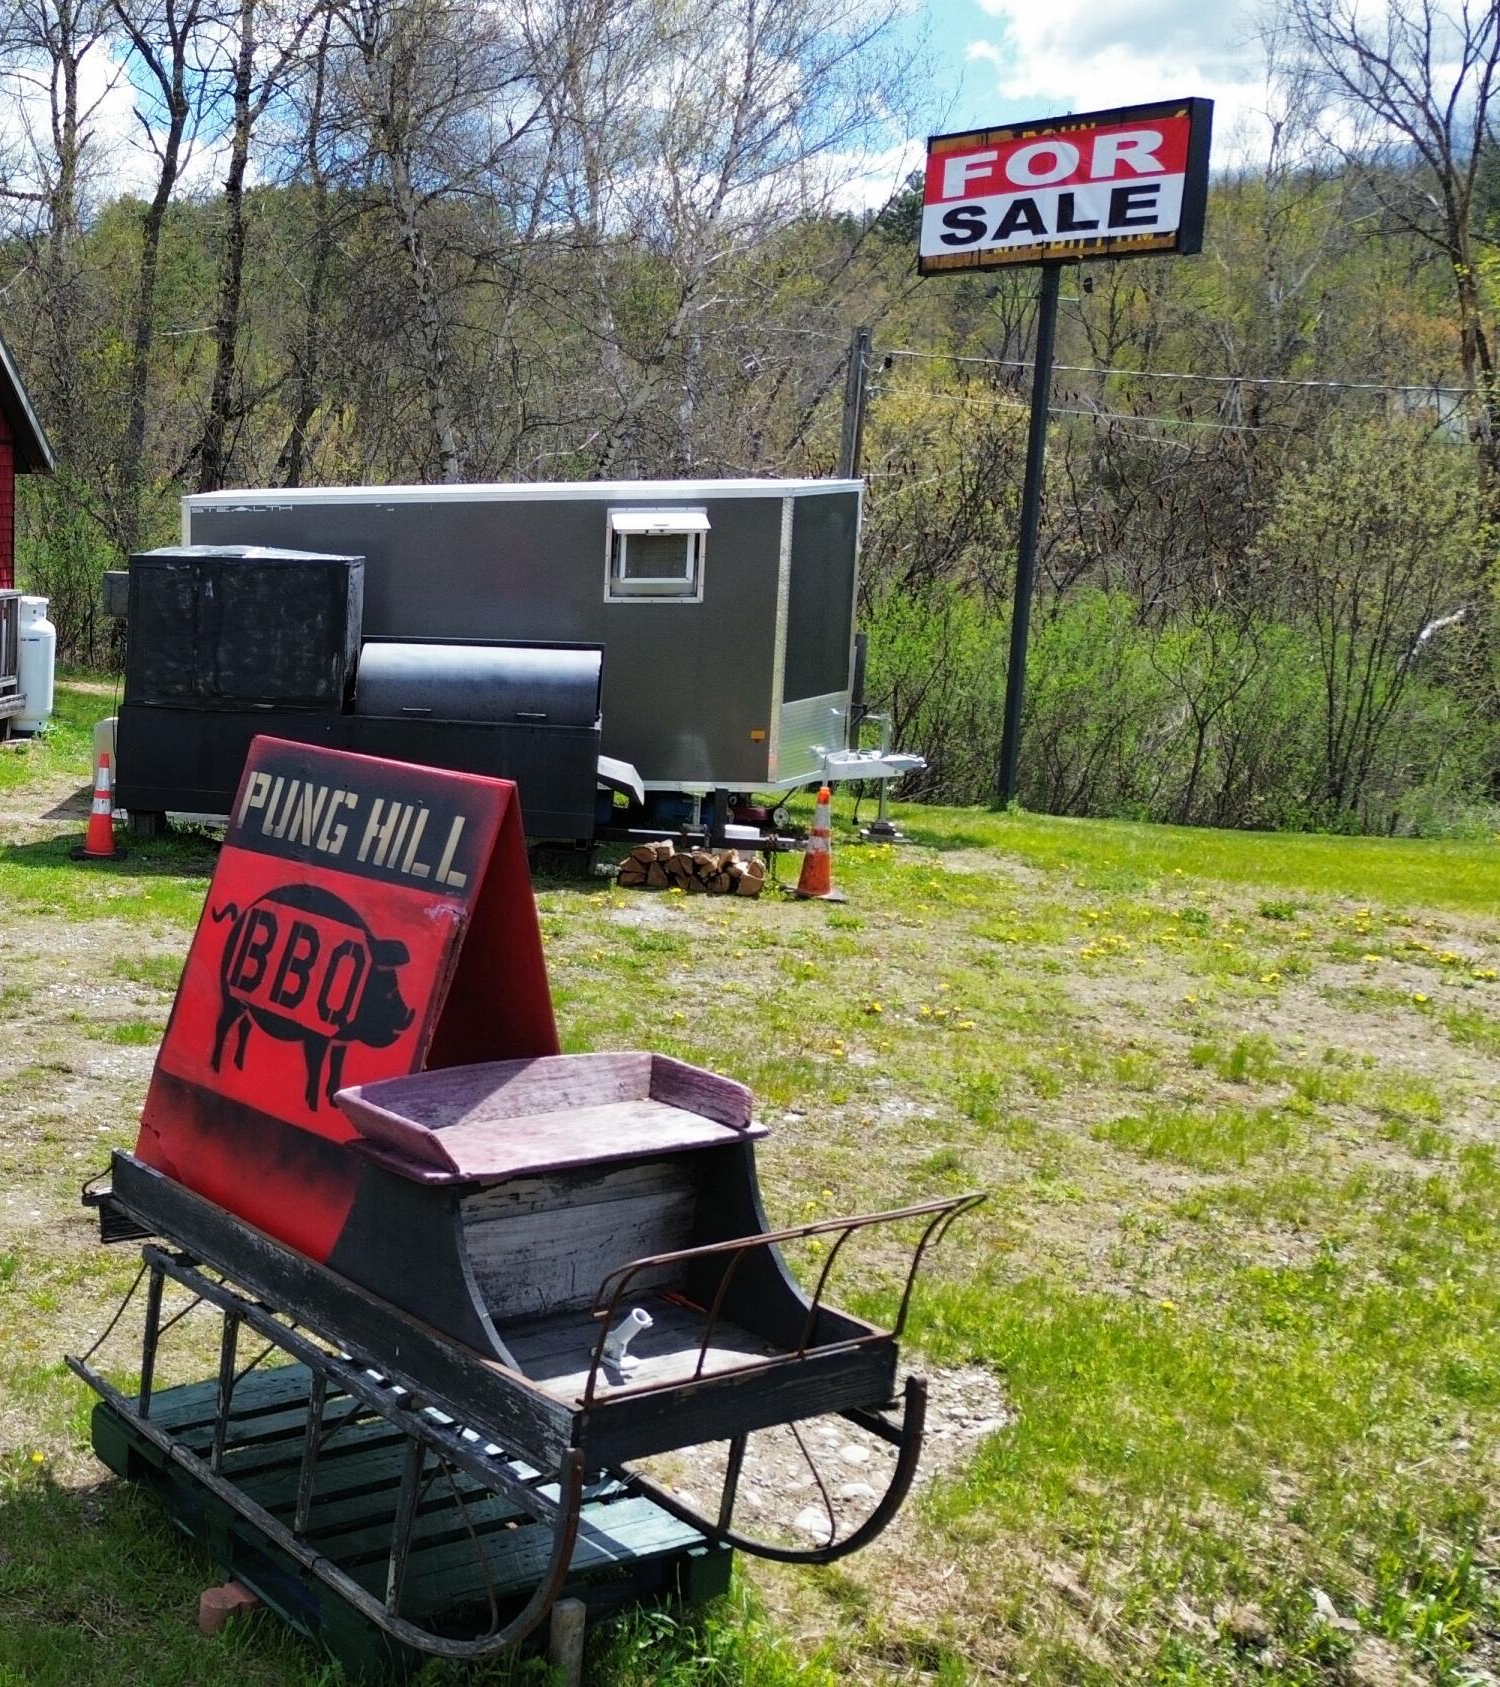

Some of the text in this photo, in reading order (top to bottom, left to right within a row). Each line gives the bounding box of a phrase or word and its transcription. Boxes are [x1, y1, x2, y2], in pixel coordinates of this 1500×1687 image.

[942, 130, 1165, 199] FOR
[939, 183, 1162, 246] SALE
[191, 504, 292, 513] STEALTH
[236, 771, 467, 888] PUNG HILL
[229, 908, 367, 1030] BBQ
